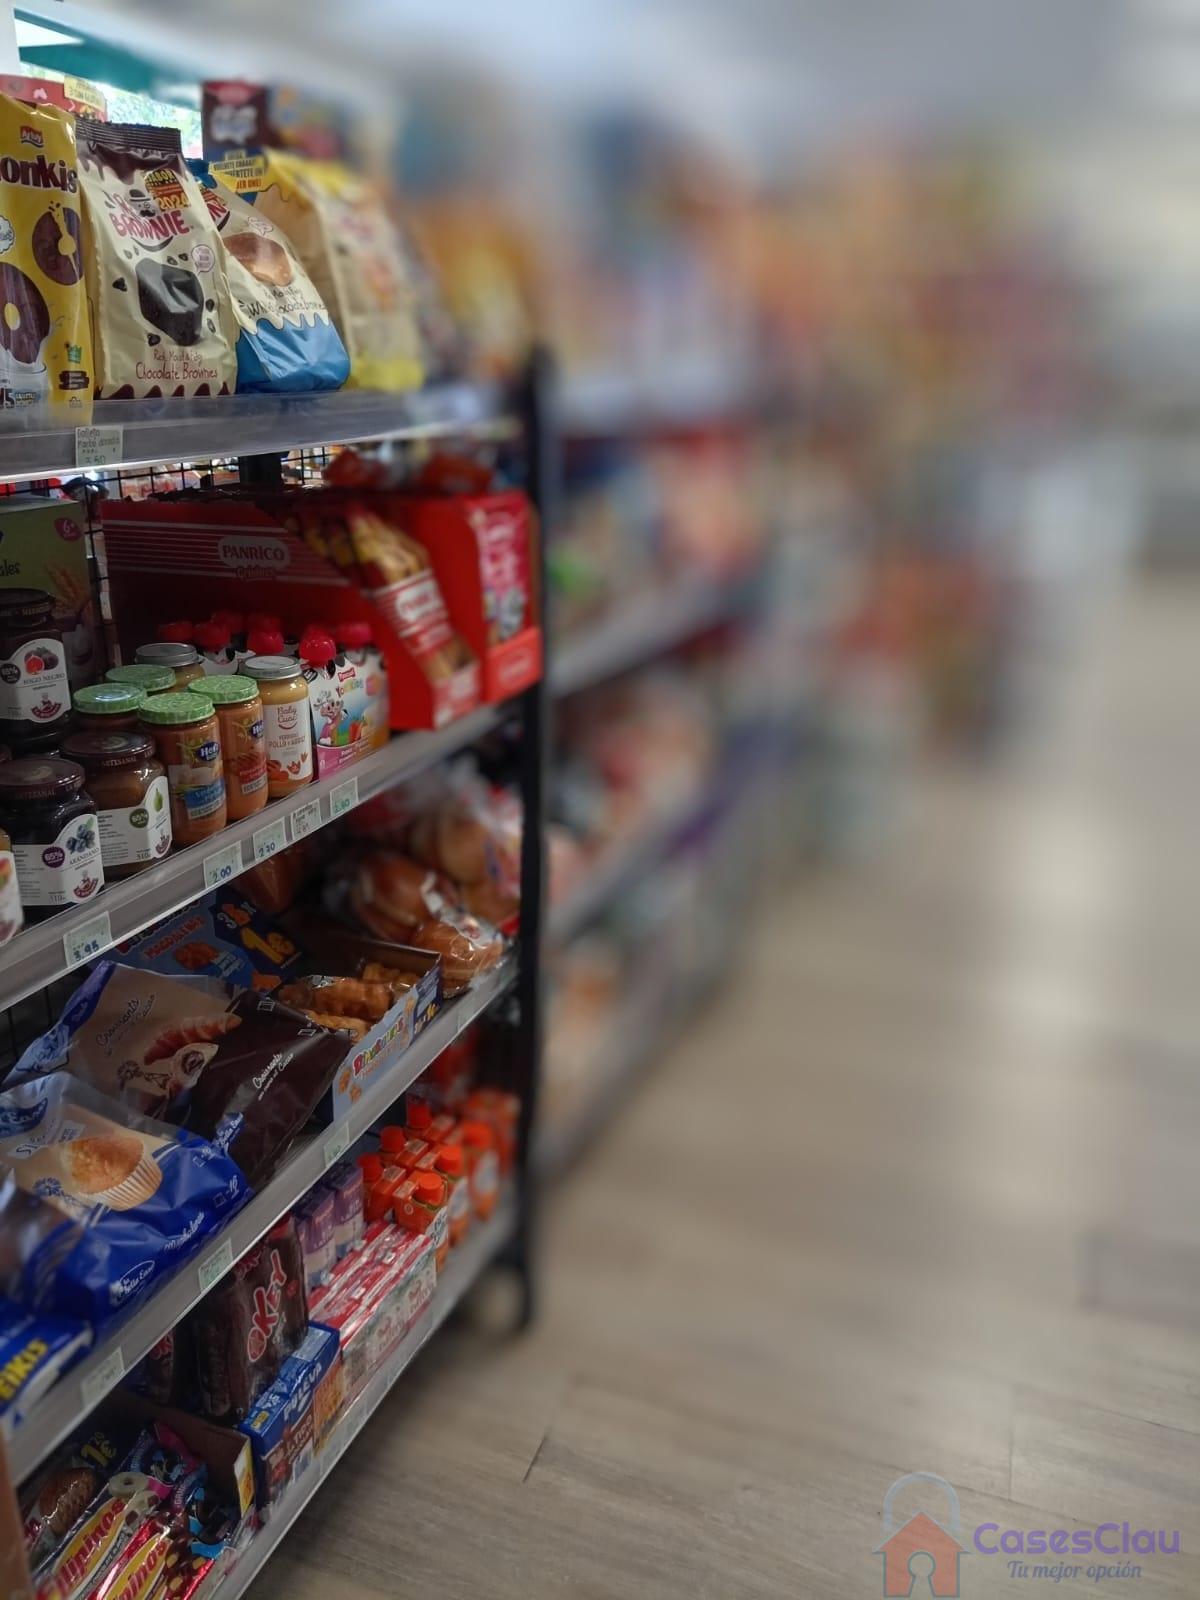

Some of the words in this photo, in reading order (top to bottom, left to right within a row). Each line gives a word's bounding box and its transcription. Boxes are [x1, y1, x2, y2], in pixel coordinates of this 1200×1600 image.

[0, 155, 77, 193] onkis
[136, 361, 179, 380] Chocolate
[183, 361, 218, 380] Brownies
[222, 544, 286, 561] PANRICO
[284, 1362, 322, 1420] PULEVA
